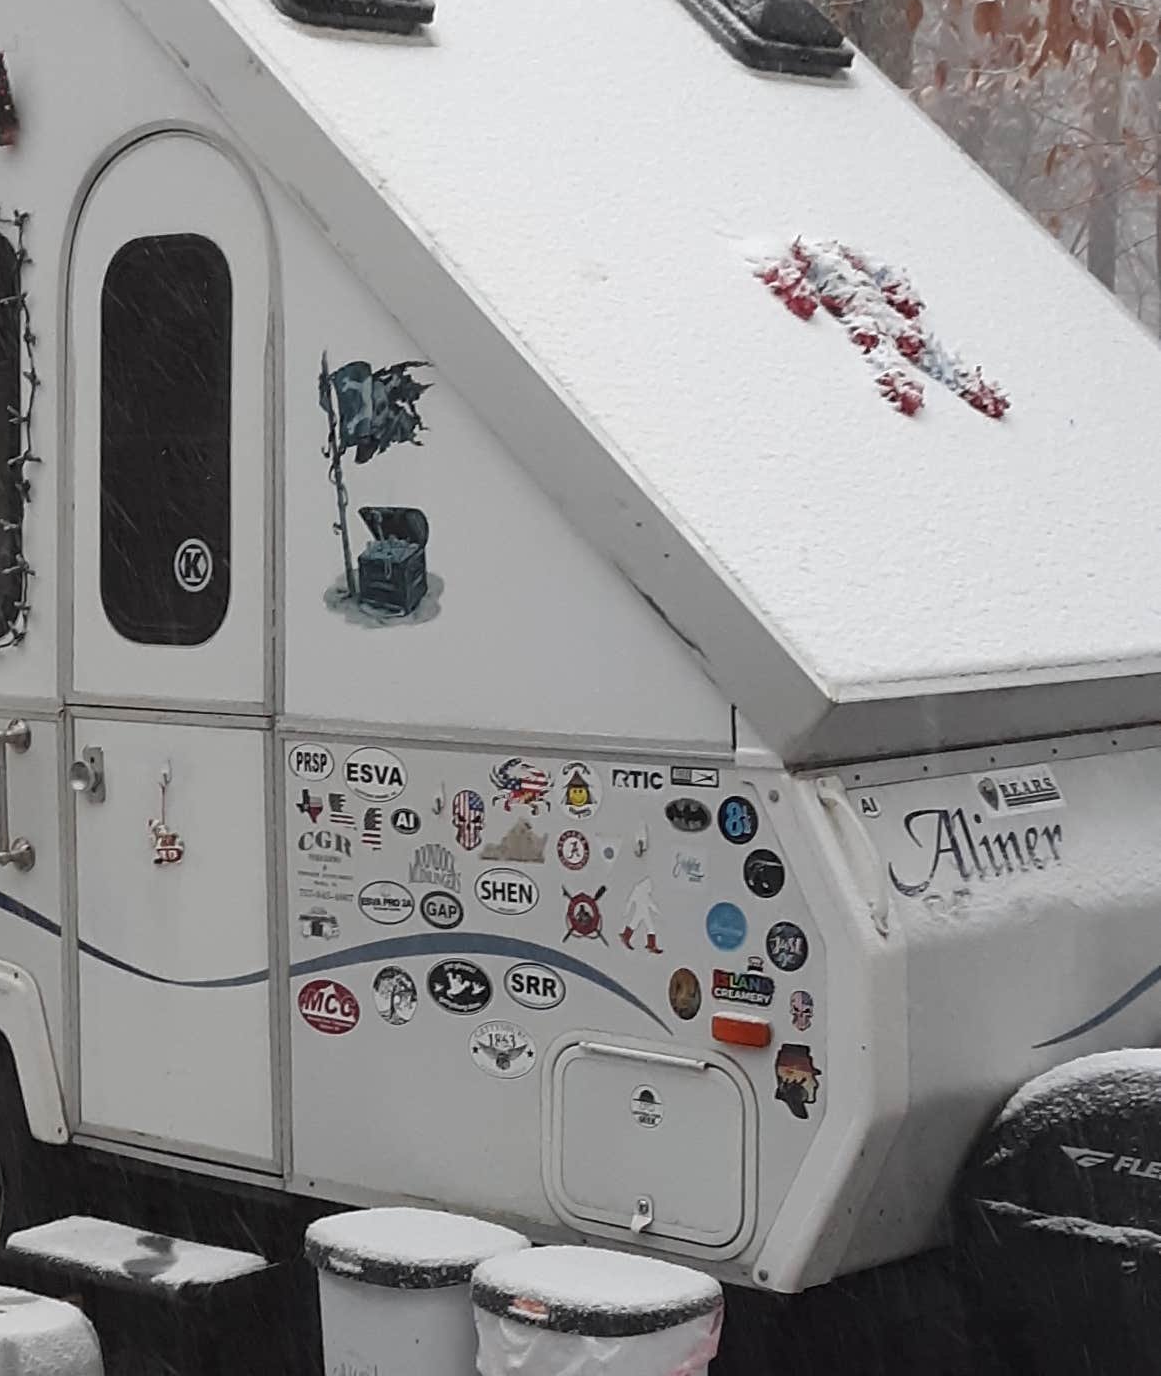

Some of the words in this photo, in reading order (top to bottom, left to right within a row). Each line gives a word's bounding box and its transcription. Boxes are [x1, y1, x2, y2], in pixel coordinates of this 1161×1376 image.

[296, 751, 327, 773] PRSP
[346, 762, 403, 786] ESVA
[612, 768, 663, 790] RTIC
[298, 831, 352, 858] CGR
[889, 808, 1062, 897] Aliner
[481, 880, 533, 904] SHEN
[425, 901, 458, 919] GAP
[511, 972, 558, 999] SRR
[714, 987, 771, 1004] CREAMERY
[303, 990, 355, 1017] MCC
[1113, 1155, 1161, 1181] FLE
